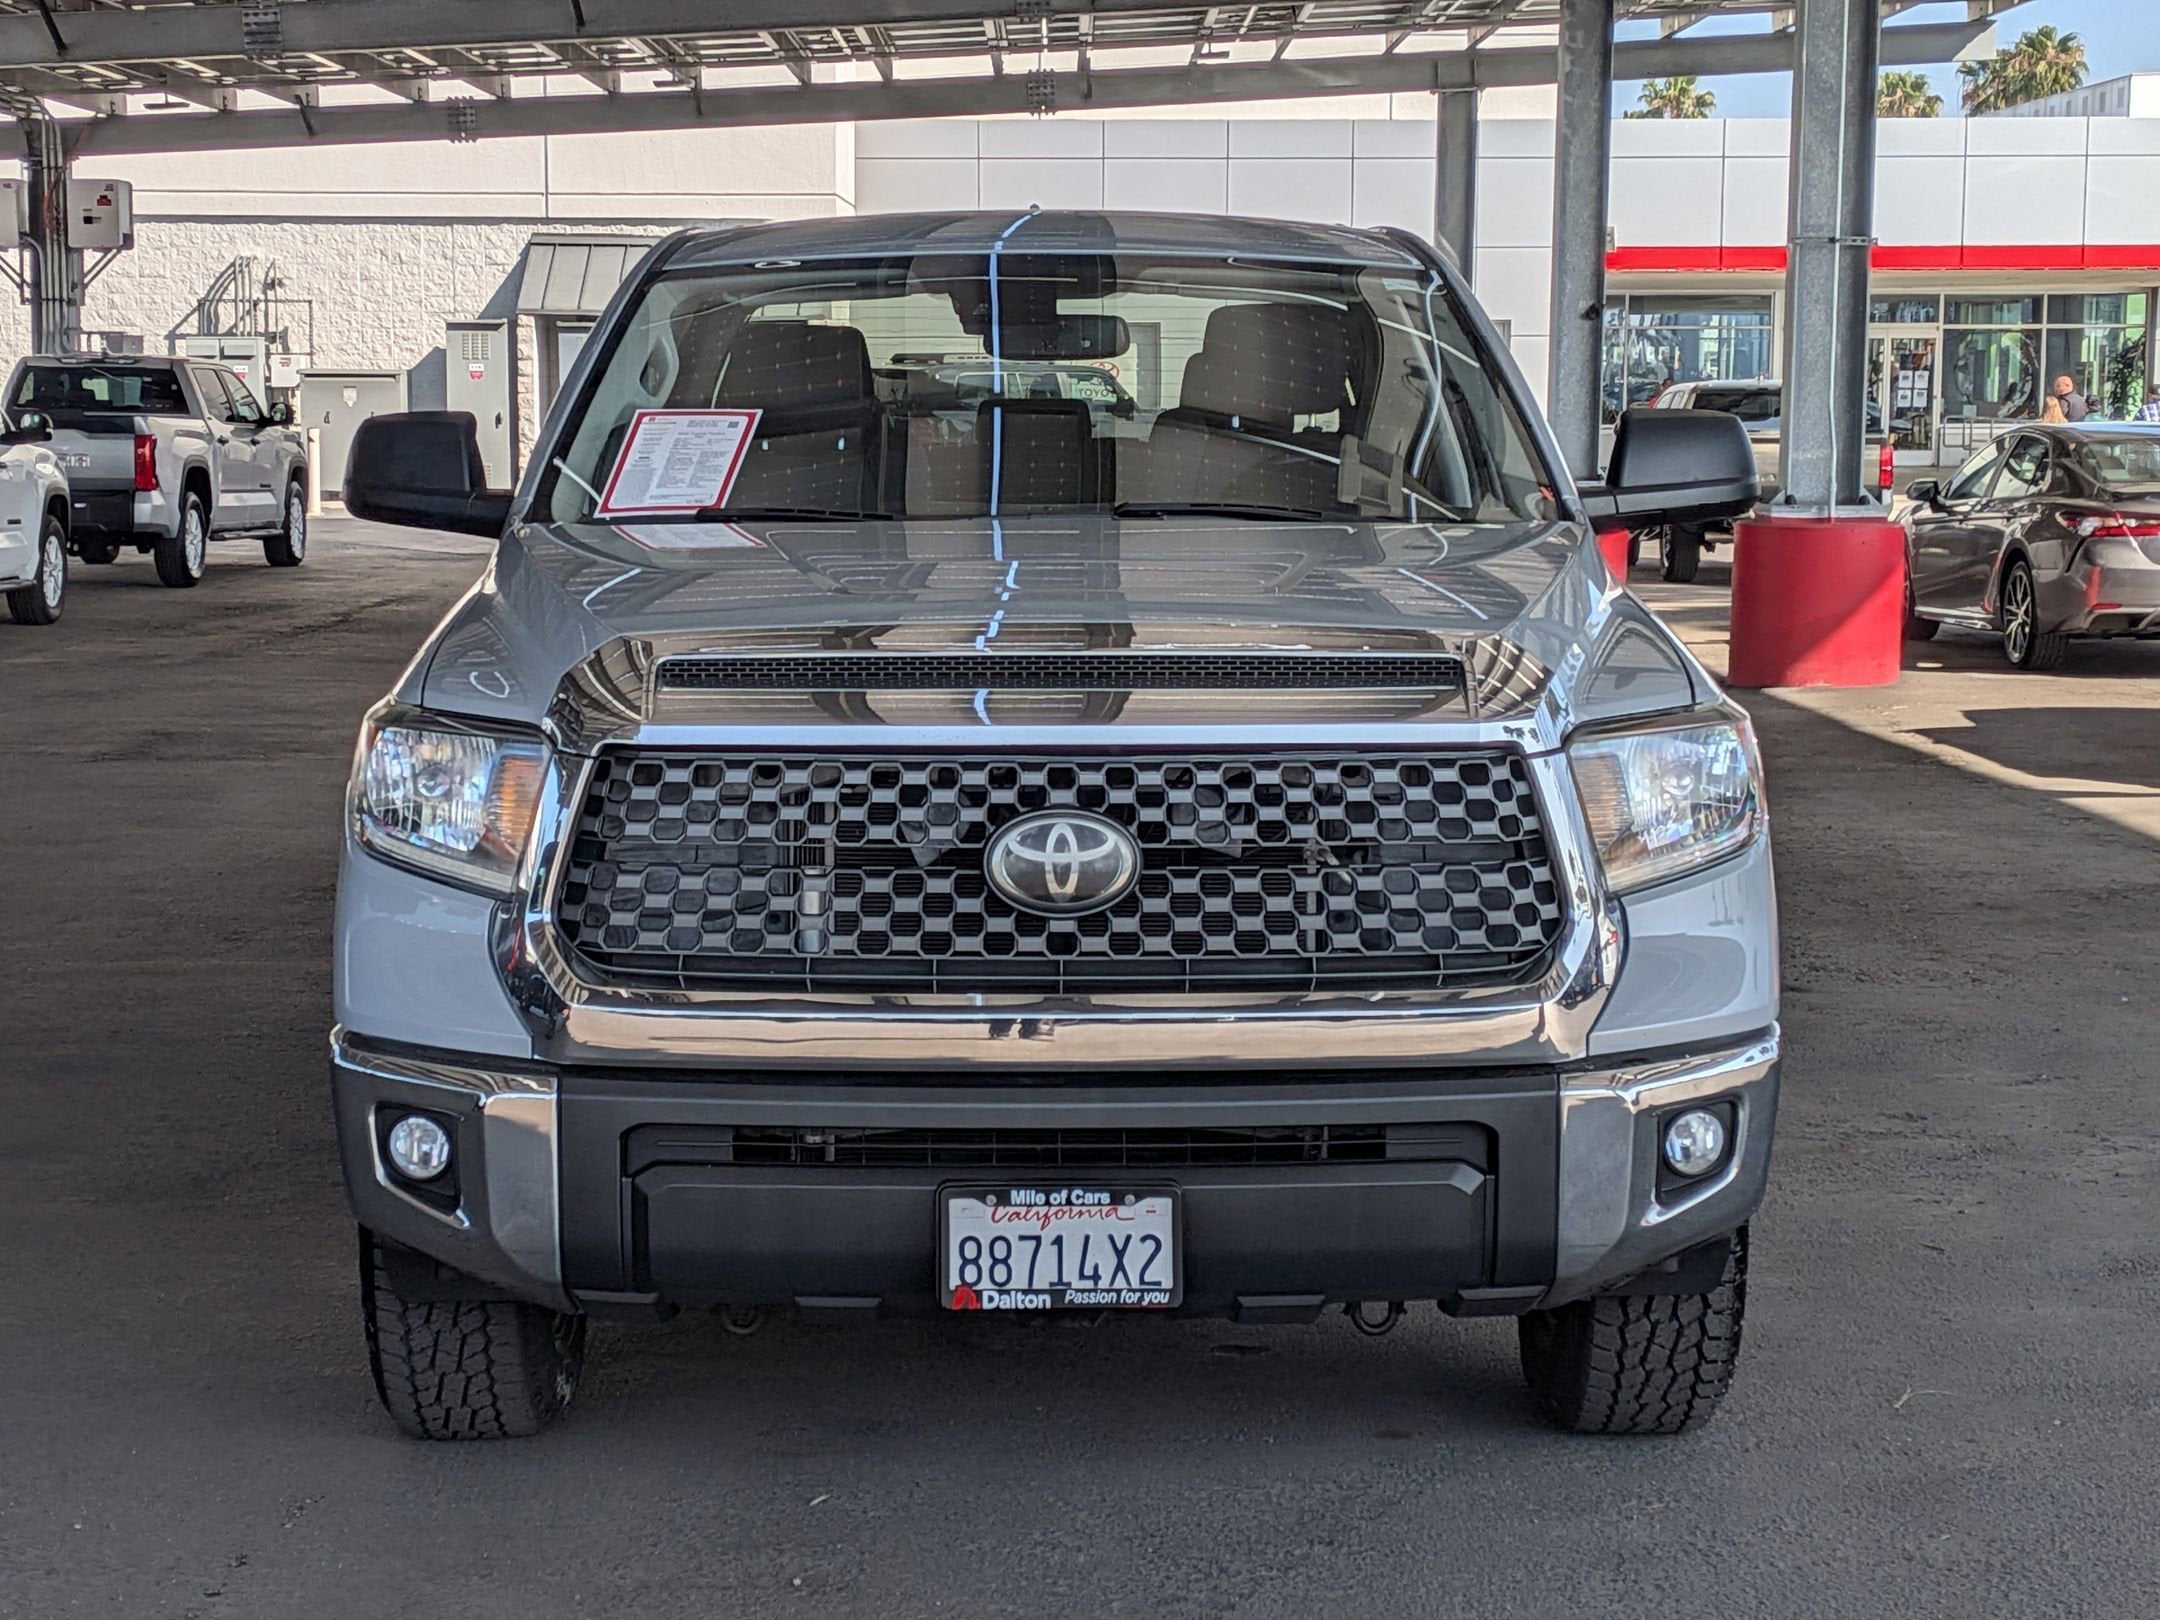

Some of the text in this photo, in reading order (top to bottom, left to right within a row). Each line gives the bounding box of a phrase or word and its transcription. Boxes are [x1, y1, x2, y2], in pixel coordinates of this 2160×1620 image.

[1010, 1188, 1111, 1206] Mile of Cars
[991, 1204, 1135, 1231] California
[958, 1233, 1163, 1288] 88714X2
[982, 1290, 1051, 1310] Dalton
[1064, 1289, 1170, 1307] Passion for you
